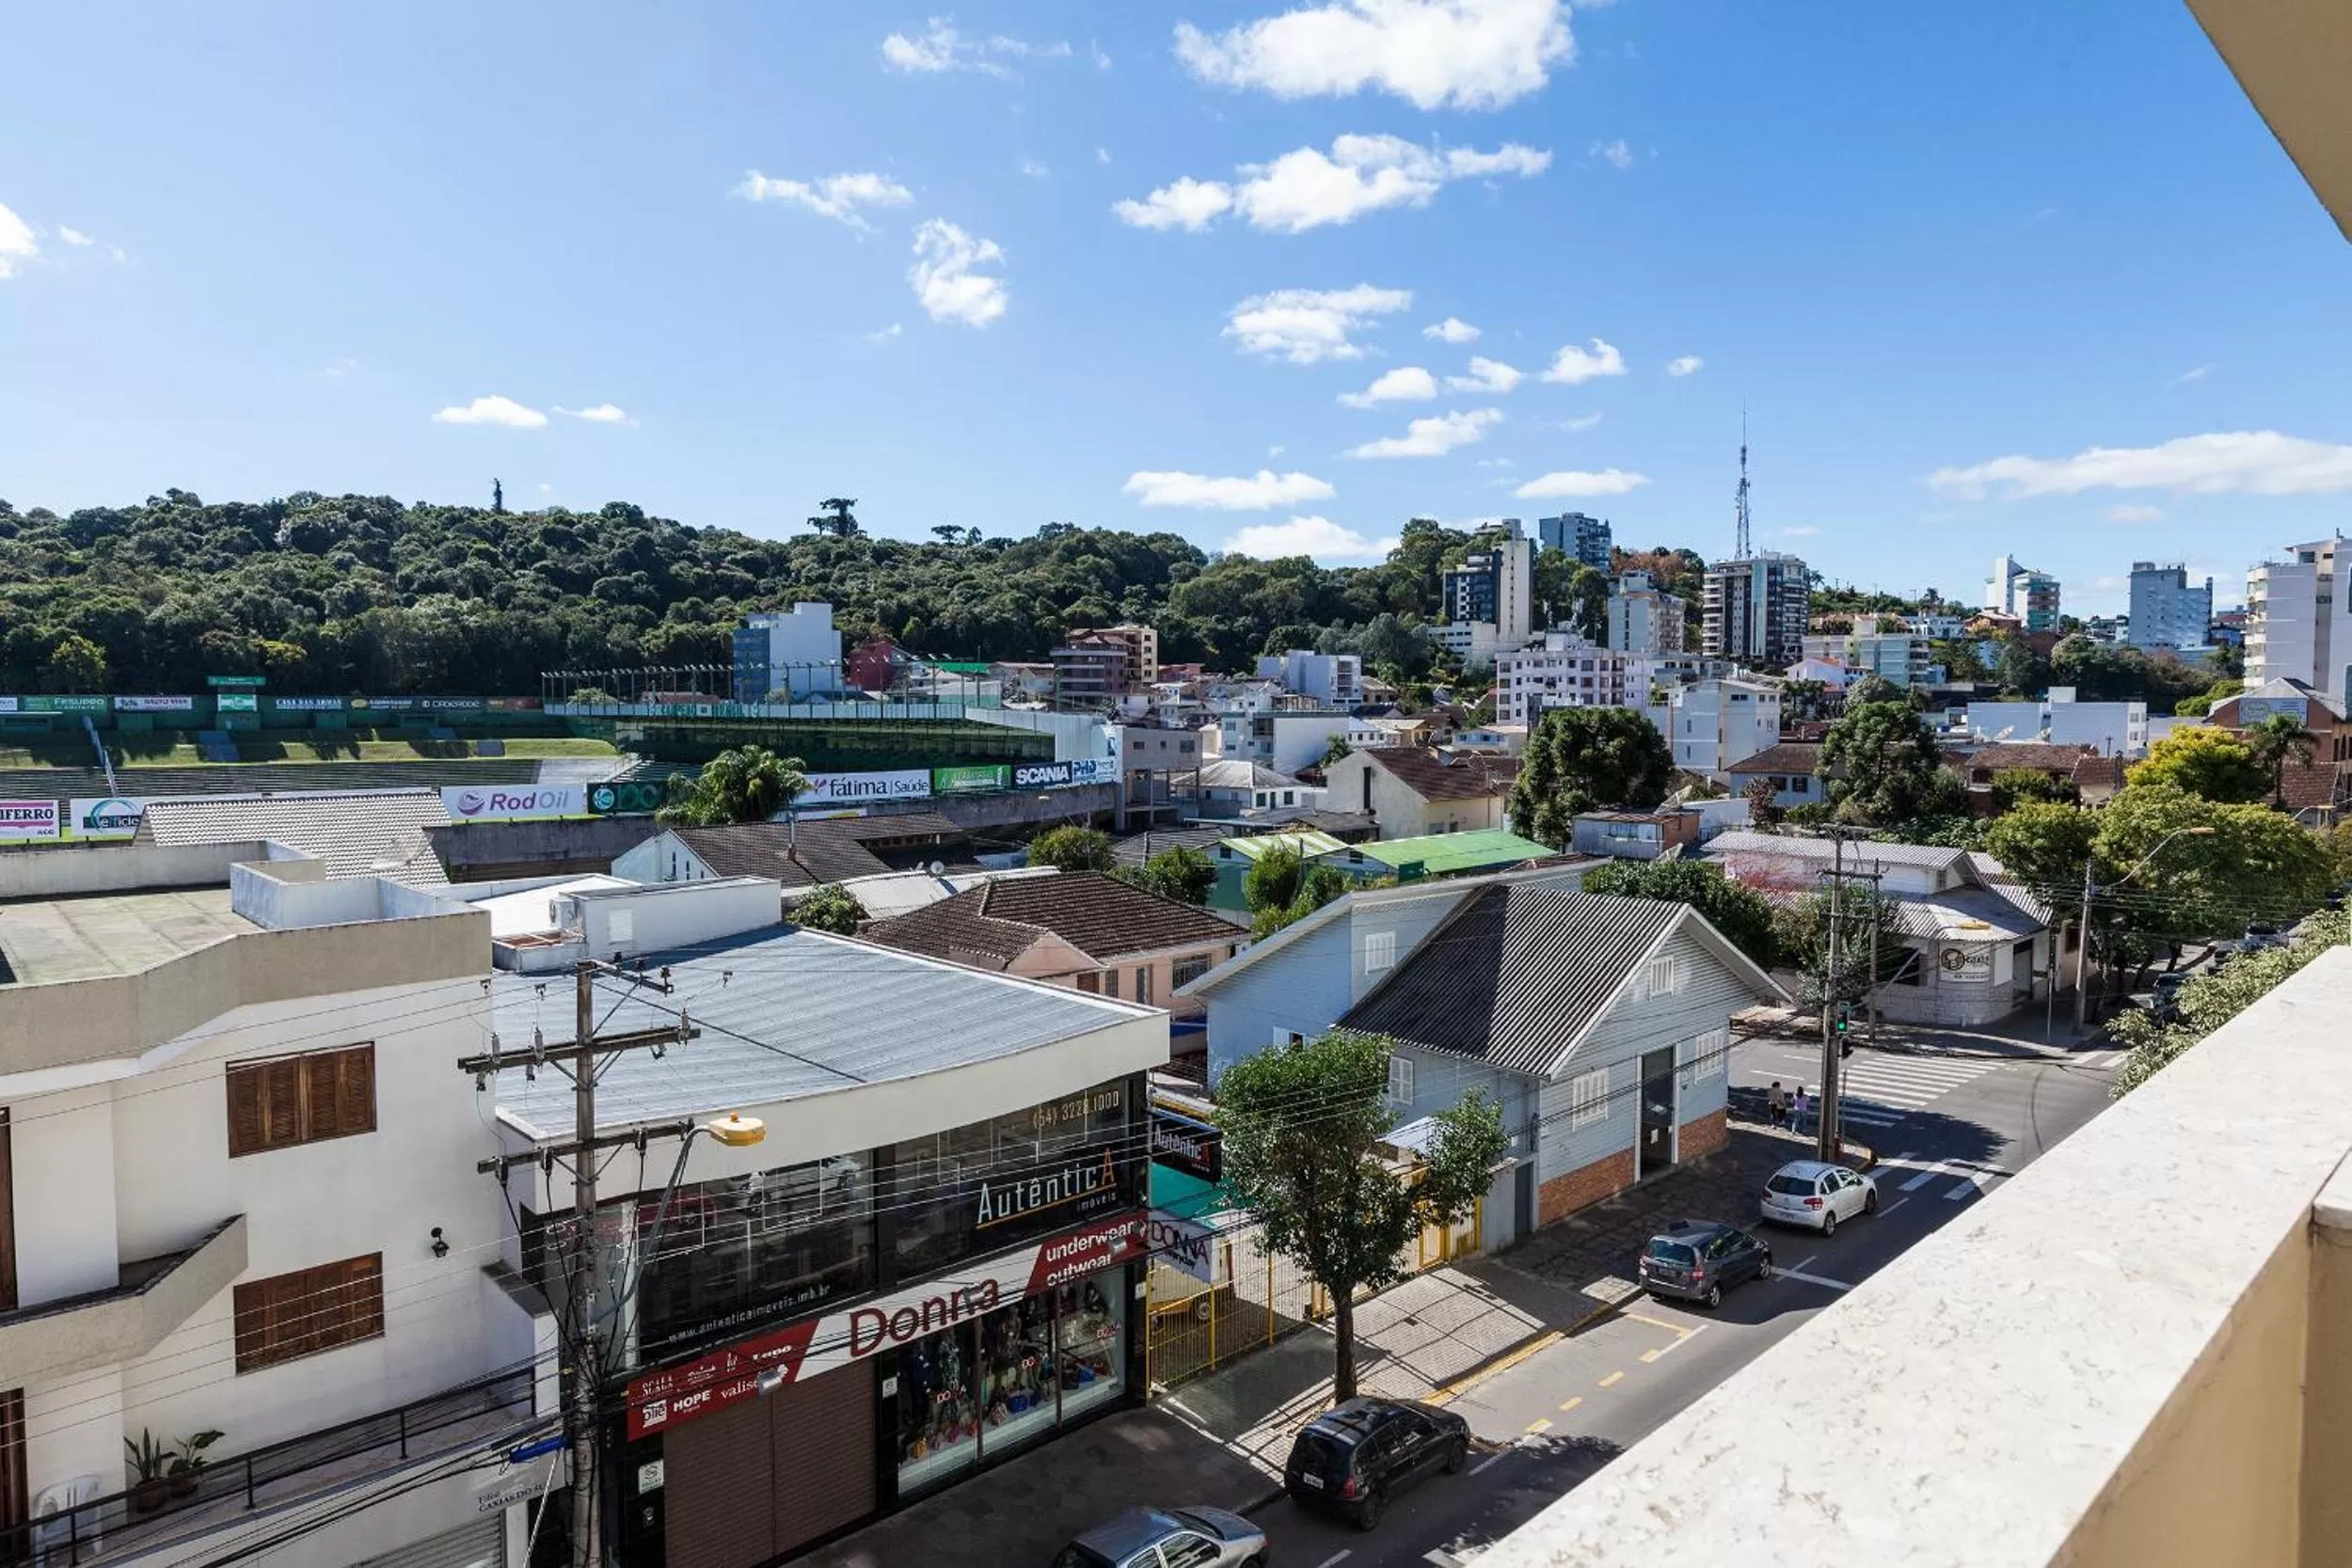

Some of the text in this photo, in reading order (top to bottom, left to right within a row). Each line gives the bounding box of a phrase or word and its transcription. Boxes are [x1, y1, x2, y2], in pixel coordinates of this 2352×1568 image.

[1016, 766, 1070, 784] SCANIA
[829, 777, 887, 797] fátima
[895, 779, 929, 793] Saúde
[977, 1148, 1115, 1225] AutênticA
[1046, 1220, 1135, 1262] underwear
[673, 1389, 712, 1412] HOPE
